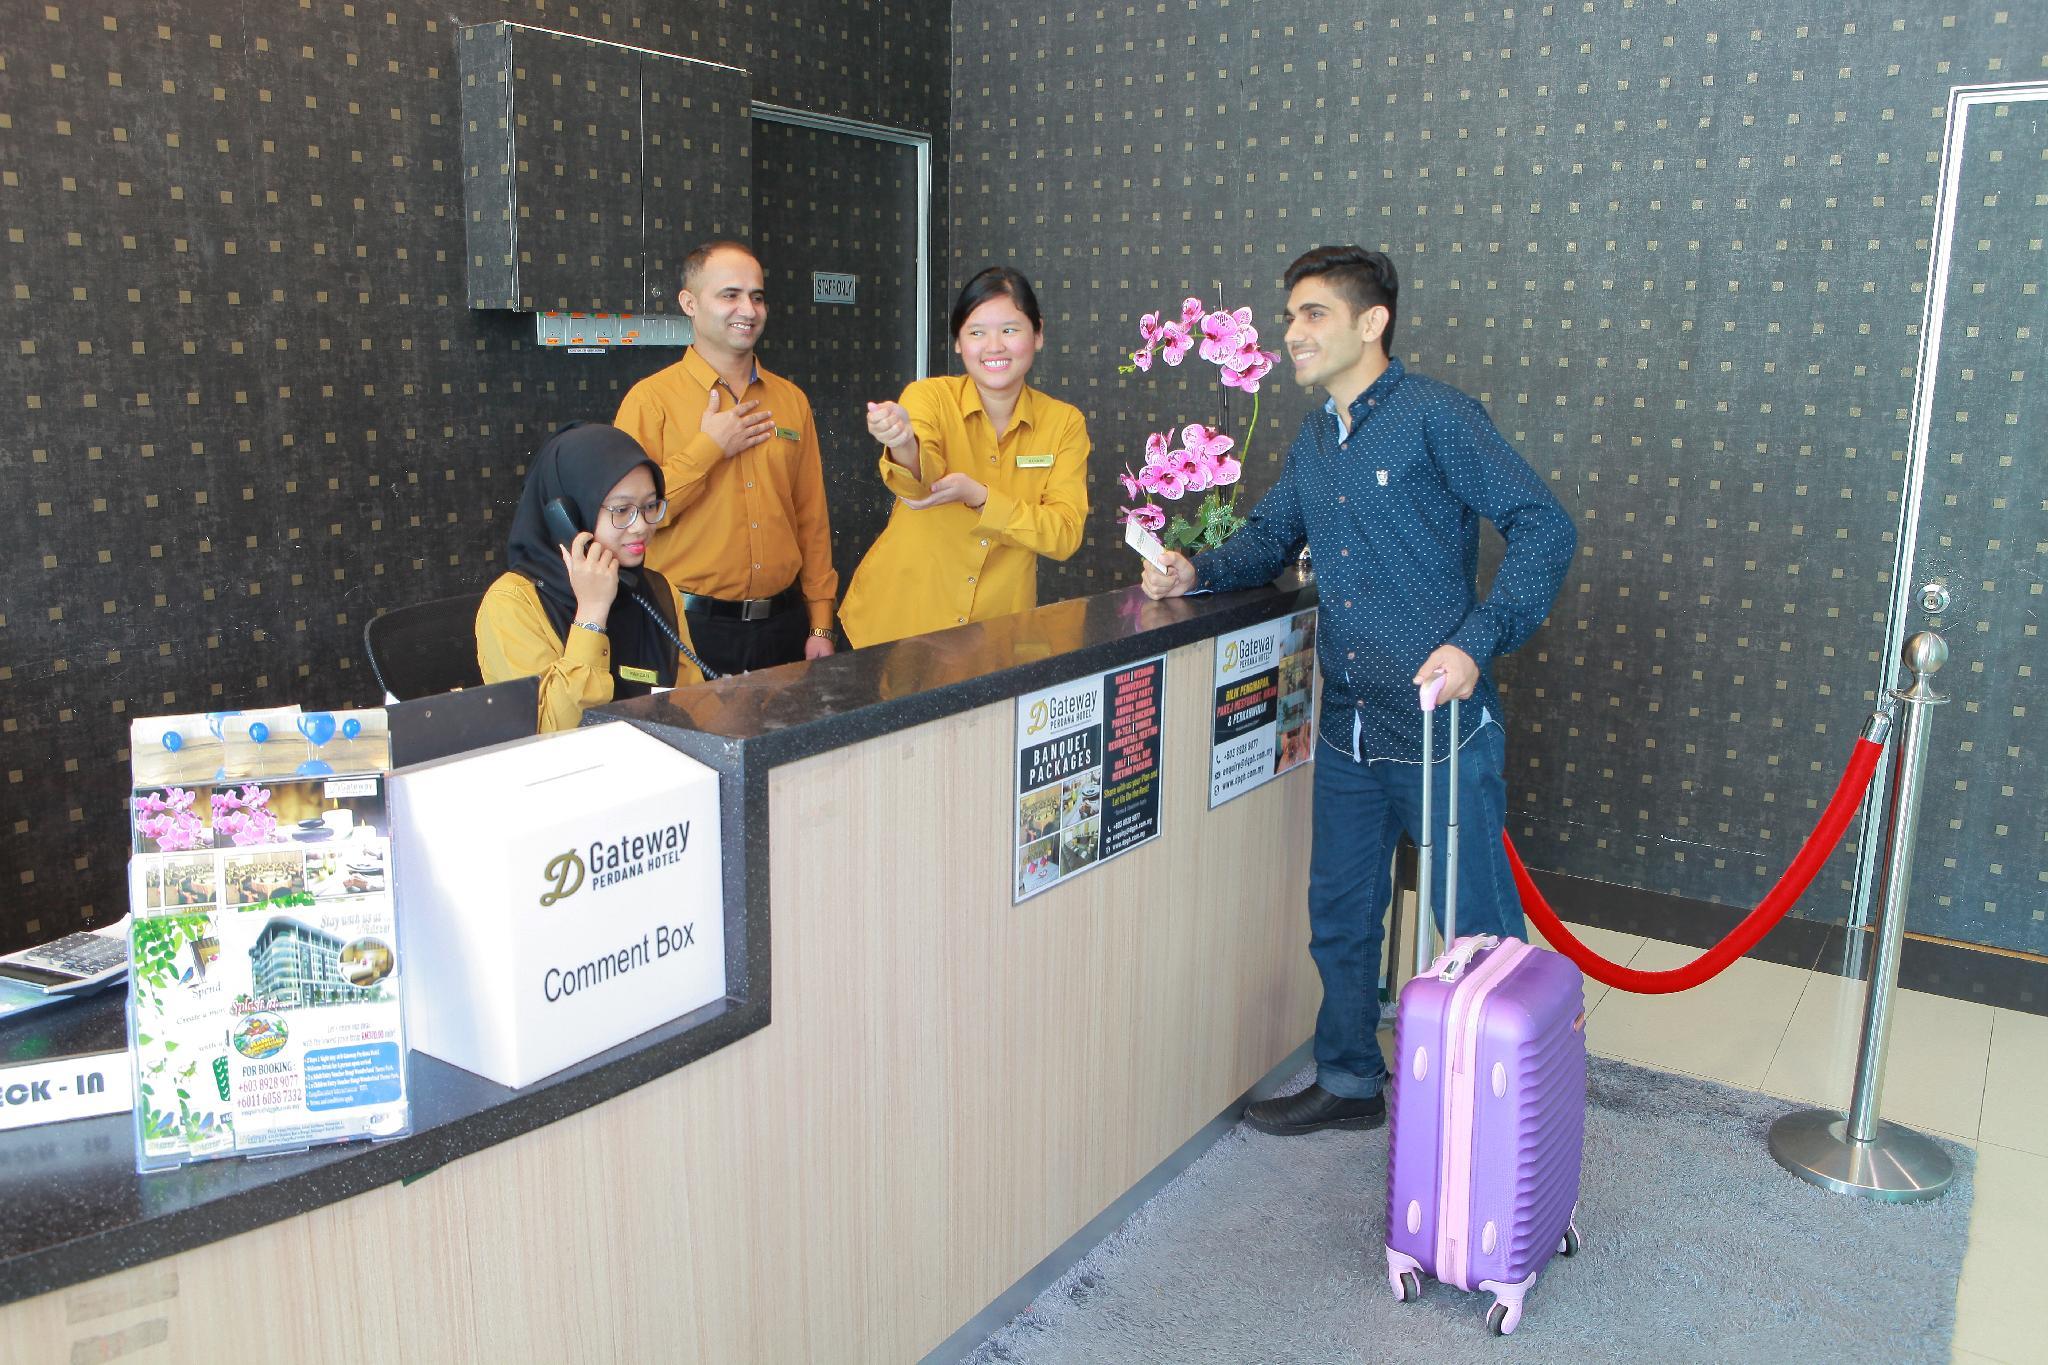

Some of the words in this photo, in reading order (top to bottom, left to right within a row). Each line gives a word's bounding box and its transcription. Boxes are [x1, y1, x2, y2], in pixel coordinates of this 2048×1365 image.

[1239, 633, 1275, 659] Gateway
[1118, 677, 1151, 695] ANNIVERSARY
[1138, 686, 1154, 699] PARTY
[1049, 690, 1098, 720] Gateway
[1050, 716, 1075, 730] PERDANA
[1077, 709, 1092, 722] HOTEL
[1033, 732, 1088, 767] BANQUET
[1123, 740, 1144, 757] PACKAGE
[1029, 748, 1091, 786] PACKAGES
[1133, 757, 1153, 774] PACKAGE
[589, 820, 690, 875] Gateway
[592, 863, 645, 891] PERDANA
[648, 850, 681, 872] HOTEL
[320, 912, 339, 931] Stay
[340, 913, 360, 926] with
[544, 934, 650, 1003] Comment
[656, 922, 695, 958] Box
[191, 980, 221, 1000] Spend
[242, 1065, 257, 1077] FOR
[258, 1060, 292, 1075] BOOKING
[0, 1079, 52, 1107] CK
[238, 1079, 258, 1093] +603
[259, 1076, 279, 1091] 8928
[280, 1073, 299, 1088] 9077
[236, 1093, 261, 1109] +6011
[262, 1090, 282, 1106] 6058
[283, 1088, 303, 1104] 7332
